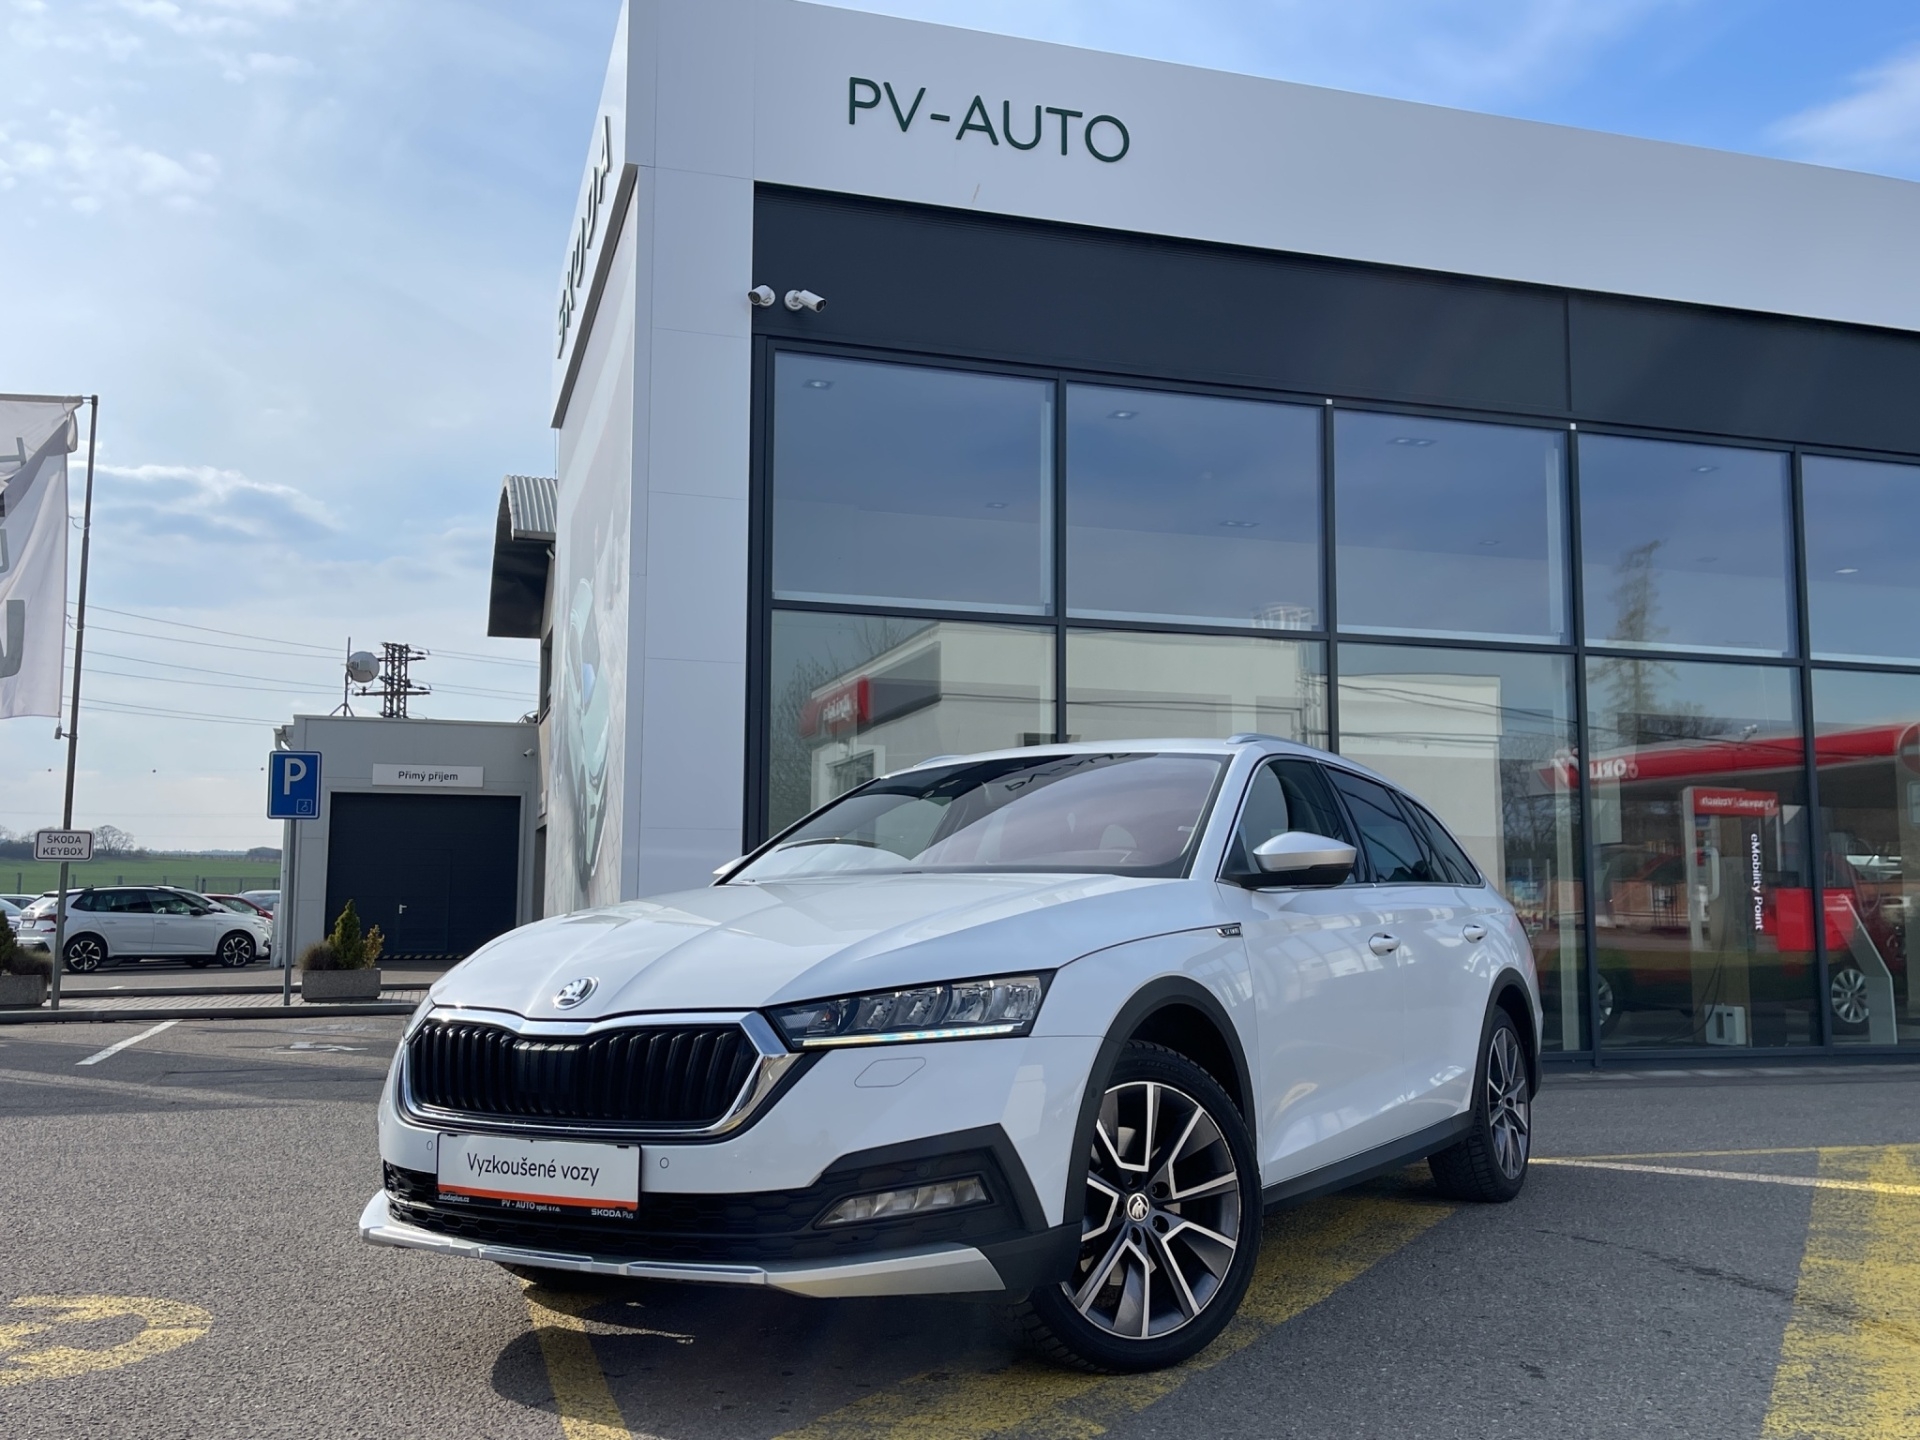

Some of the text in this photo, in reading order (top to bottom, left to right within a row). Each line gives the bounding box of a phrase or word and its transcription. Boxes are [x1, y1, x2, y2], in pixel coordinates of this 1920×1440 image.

[848, 76, 1131, 163] PV-AUTO
[283, 757, 308, 796] P
[46, 833, 82, 844] ŠKODA
[42, 846, 84, 856] KEYBOX
[1750, 833, 1765, 931] eMobility Point
[467, 1152, 600, 1187] Vyzkoušené vozy
[515, 1200, 536, 1210] AUTO
[622, 1210, 634, 1219] Plus
